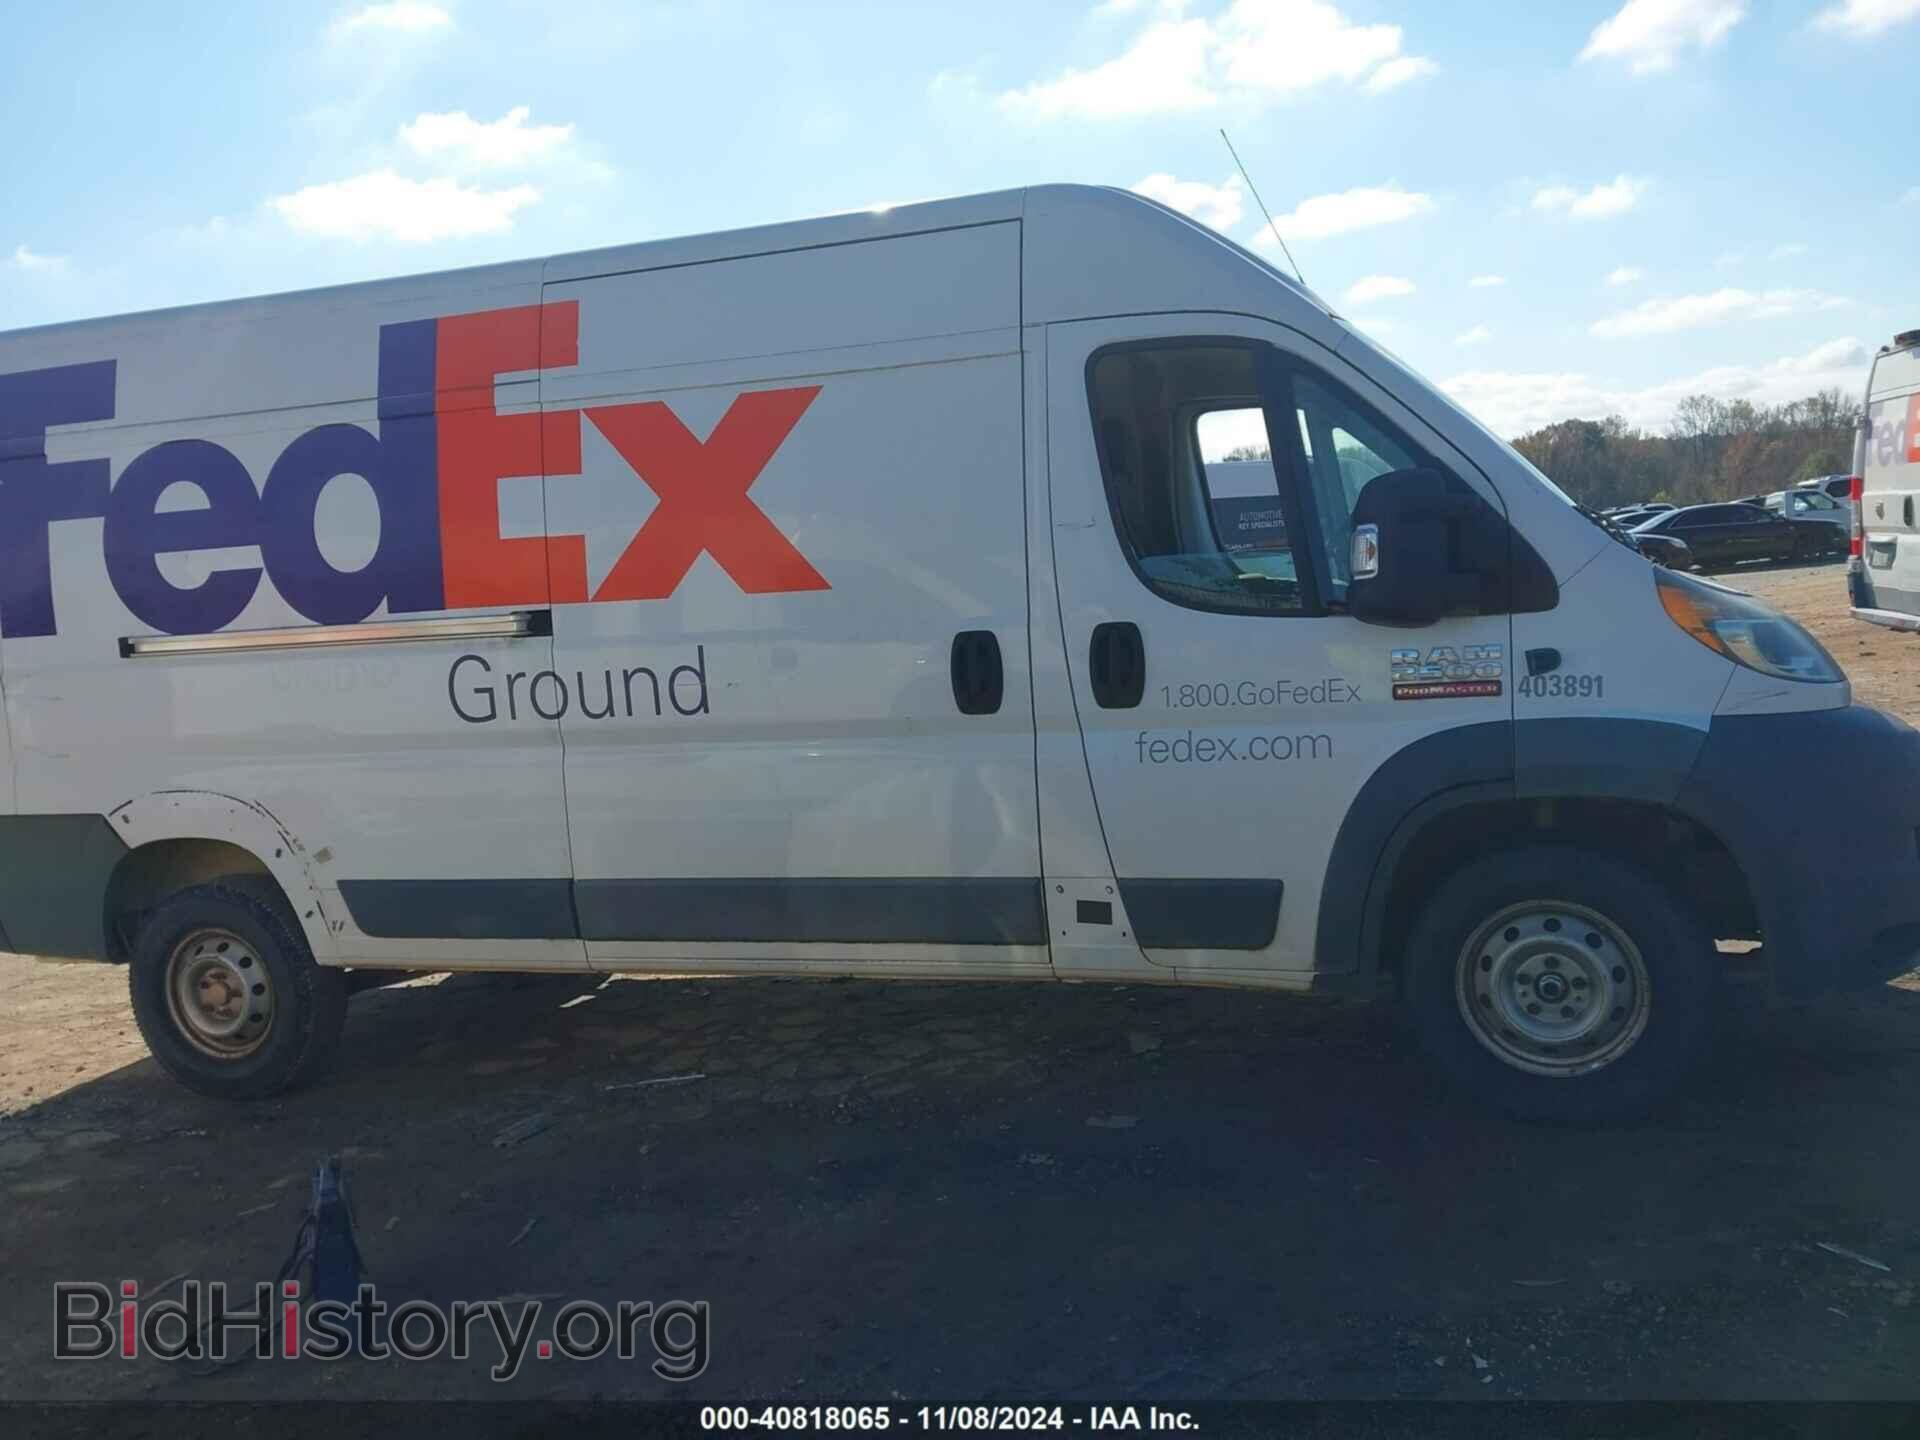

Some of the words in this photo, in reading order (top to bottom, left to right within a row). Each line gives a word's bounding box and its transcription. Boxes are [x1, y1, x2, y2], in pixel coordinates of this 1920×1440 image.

[0, 300, 831, 638] FedEx
[1391, 643, 1504, 665] RAM
[447, 644, 711, 723] Ground
[1391, 661, 1504, 681] 2500
[1161, 678, 1361, 708] 1.800.GoFedEx
[1518, 674, 1604, 699] 403891
[1136, 729, 1333, 765] fedex.com
